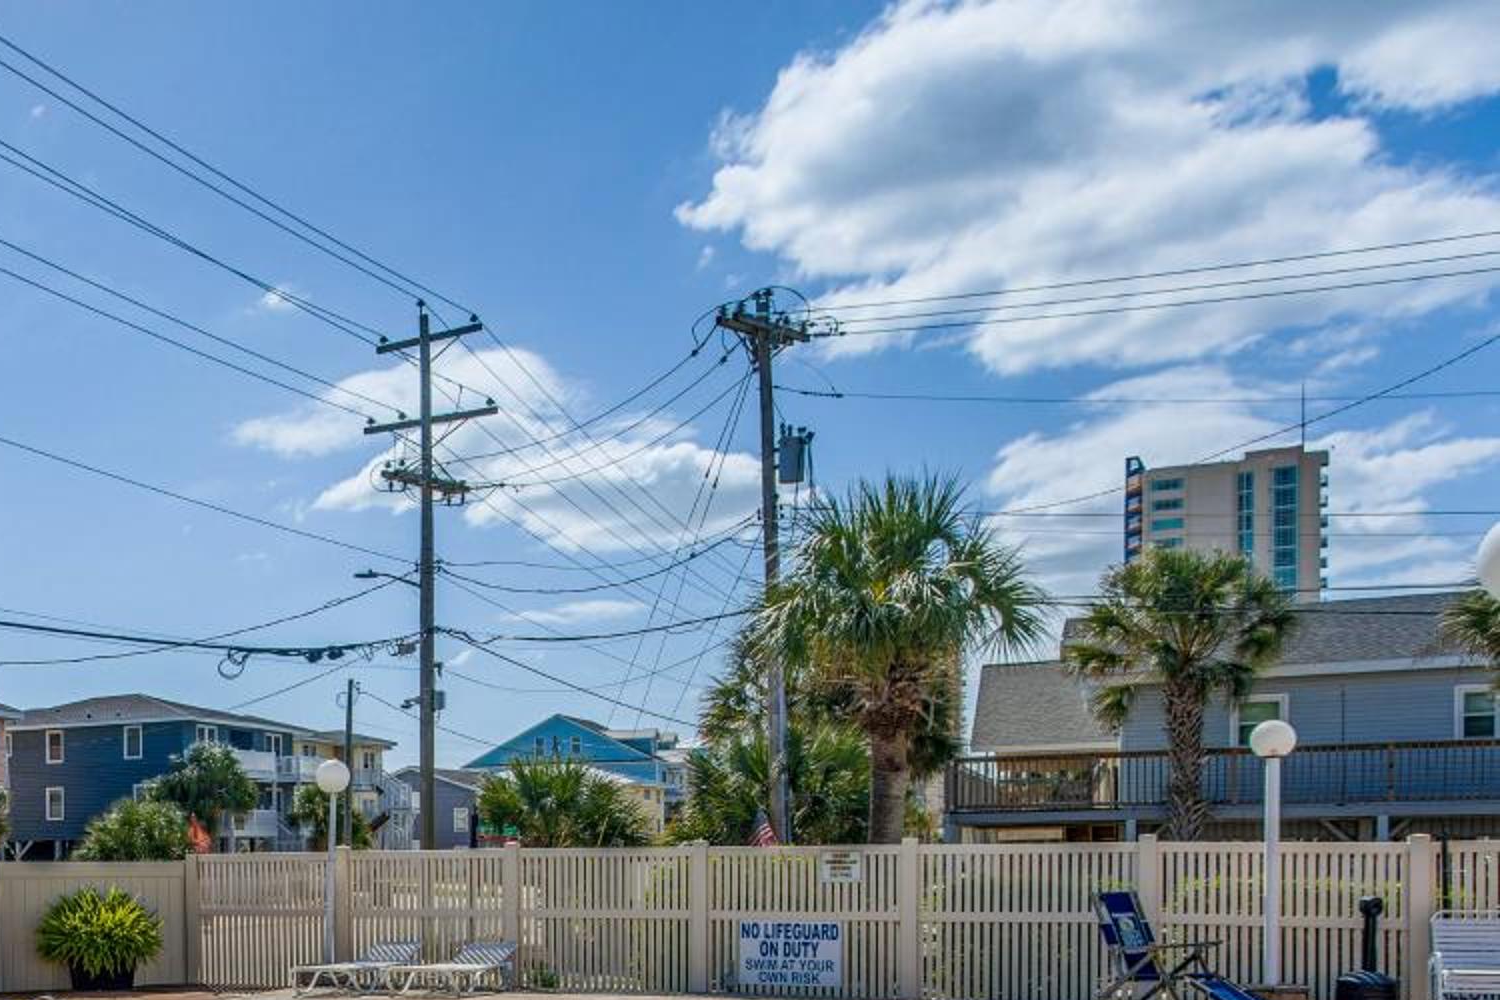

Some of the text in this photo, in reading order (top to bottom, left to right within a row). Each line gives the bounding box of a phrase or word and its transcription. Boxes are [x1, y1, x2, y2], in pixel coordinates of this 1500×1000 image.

[741, 922, 839, 941] NO LIFEGUARD
[759, 941, 819, 958] ON DUTY
[745, 959, 835, 972] SWIM AT YOUR
[758, 972, 821, 984] OWN RISK
